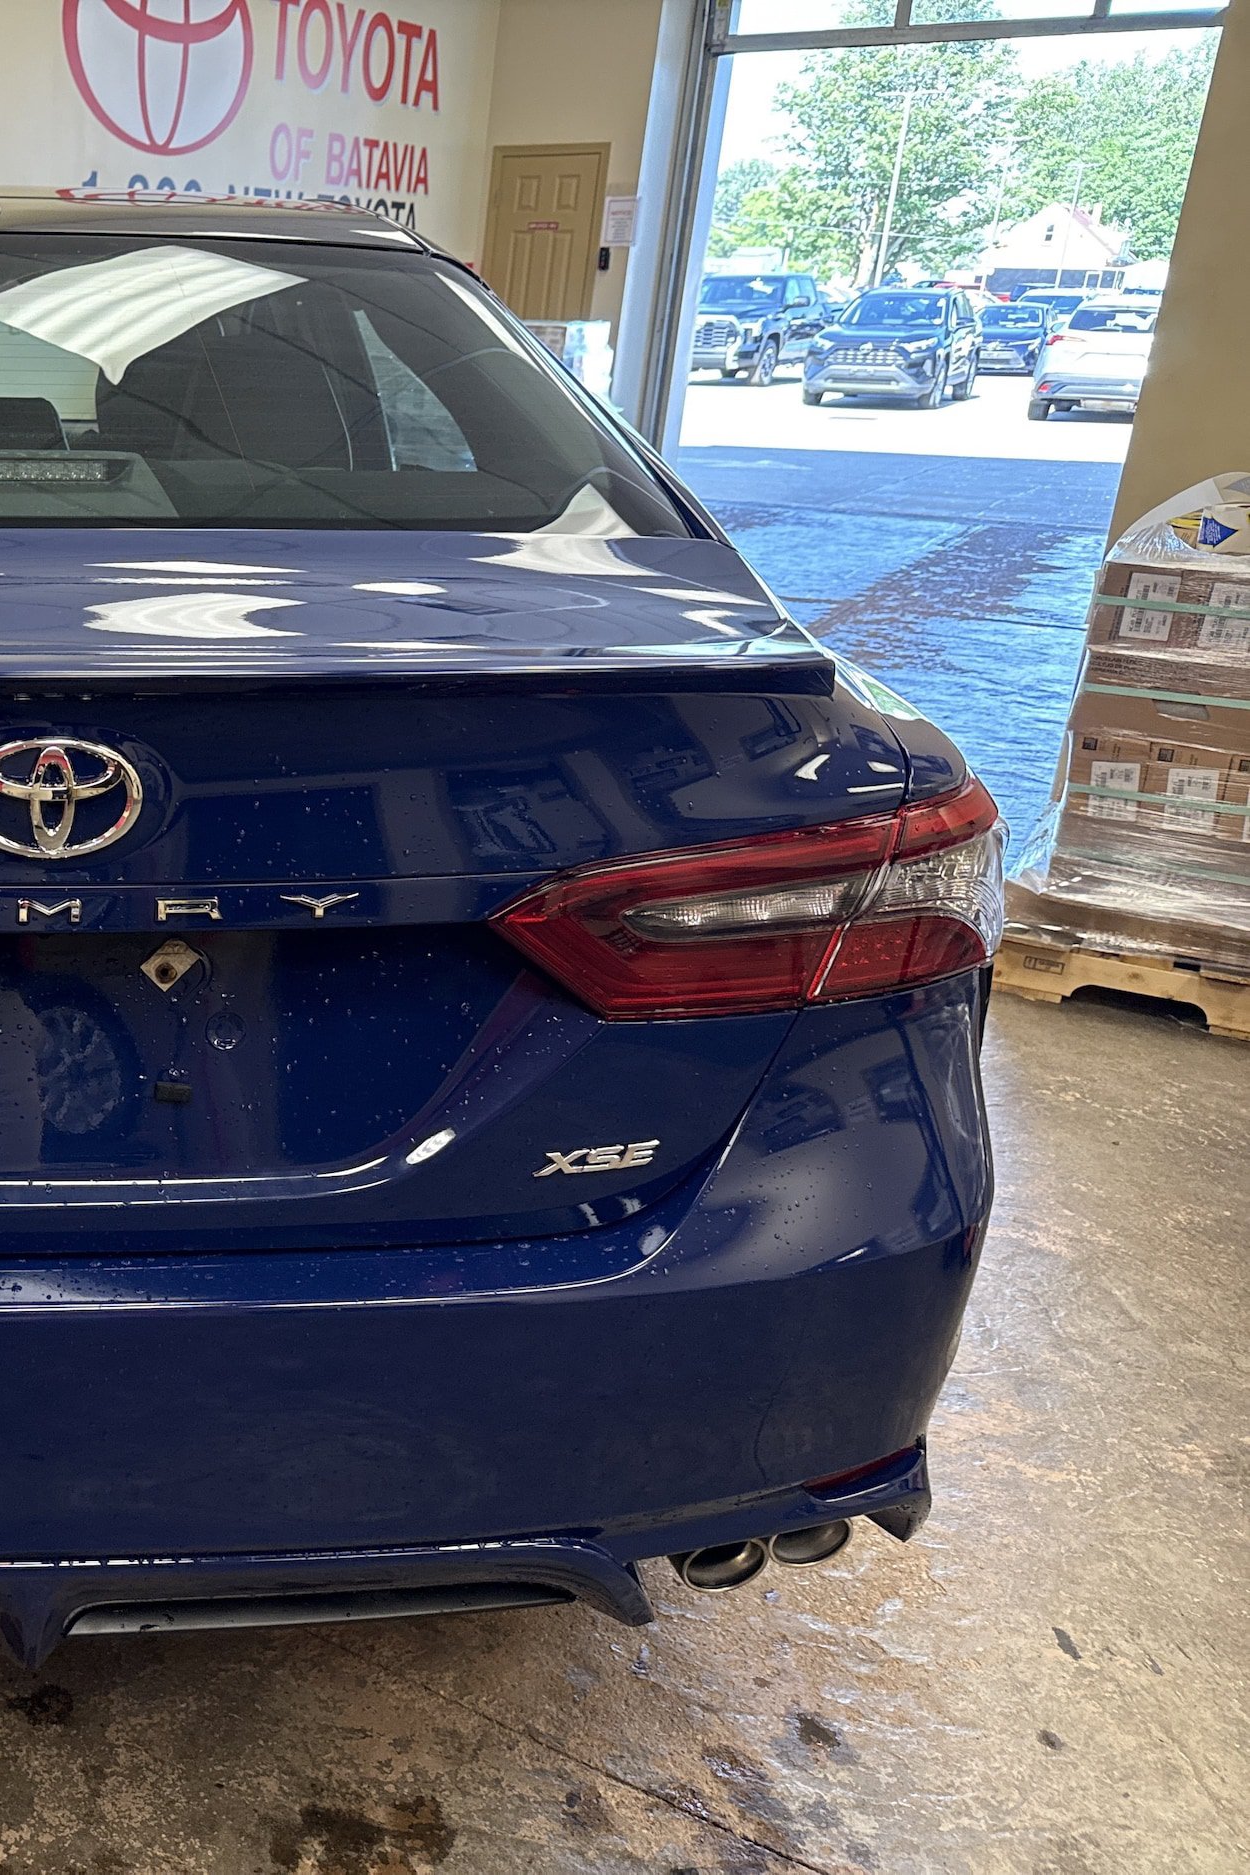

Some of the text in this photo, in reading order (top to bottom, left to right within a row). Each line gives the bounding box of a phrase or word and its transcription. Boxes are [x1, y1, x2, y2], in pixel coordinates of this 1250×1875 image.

[271, 0, 439, 112] TOYOTA
[269, 122, 429, 195] OF BATAVIA
[532, 1139, 661, 1178] XSE
